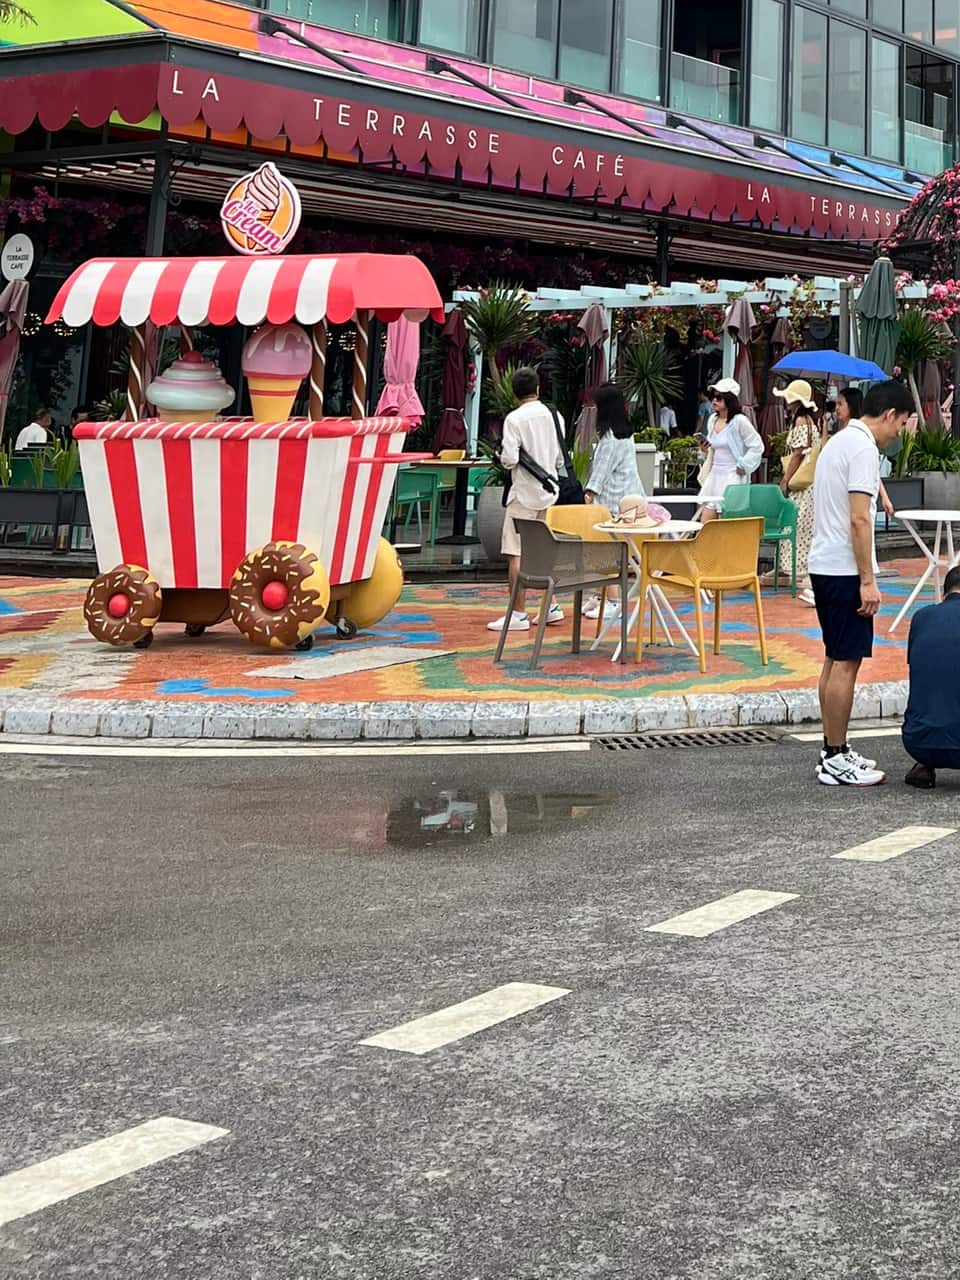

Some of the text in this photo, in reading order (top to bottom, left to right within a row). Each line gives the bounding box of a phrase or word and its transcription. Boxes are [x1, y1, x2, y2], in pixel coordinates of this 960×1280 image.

[172, 70, 625, 177] LA TERRASSE CAFÉ
[243, 200, 260, 217] Ice
[747, 183, 771, 204] LA
[222, 200, 281, 251] Cream
